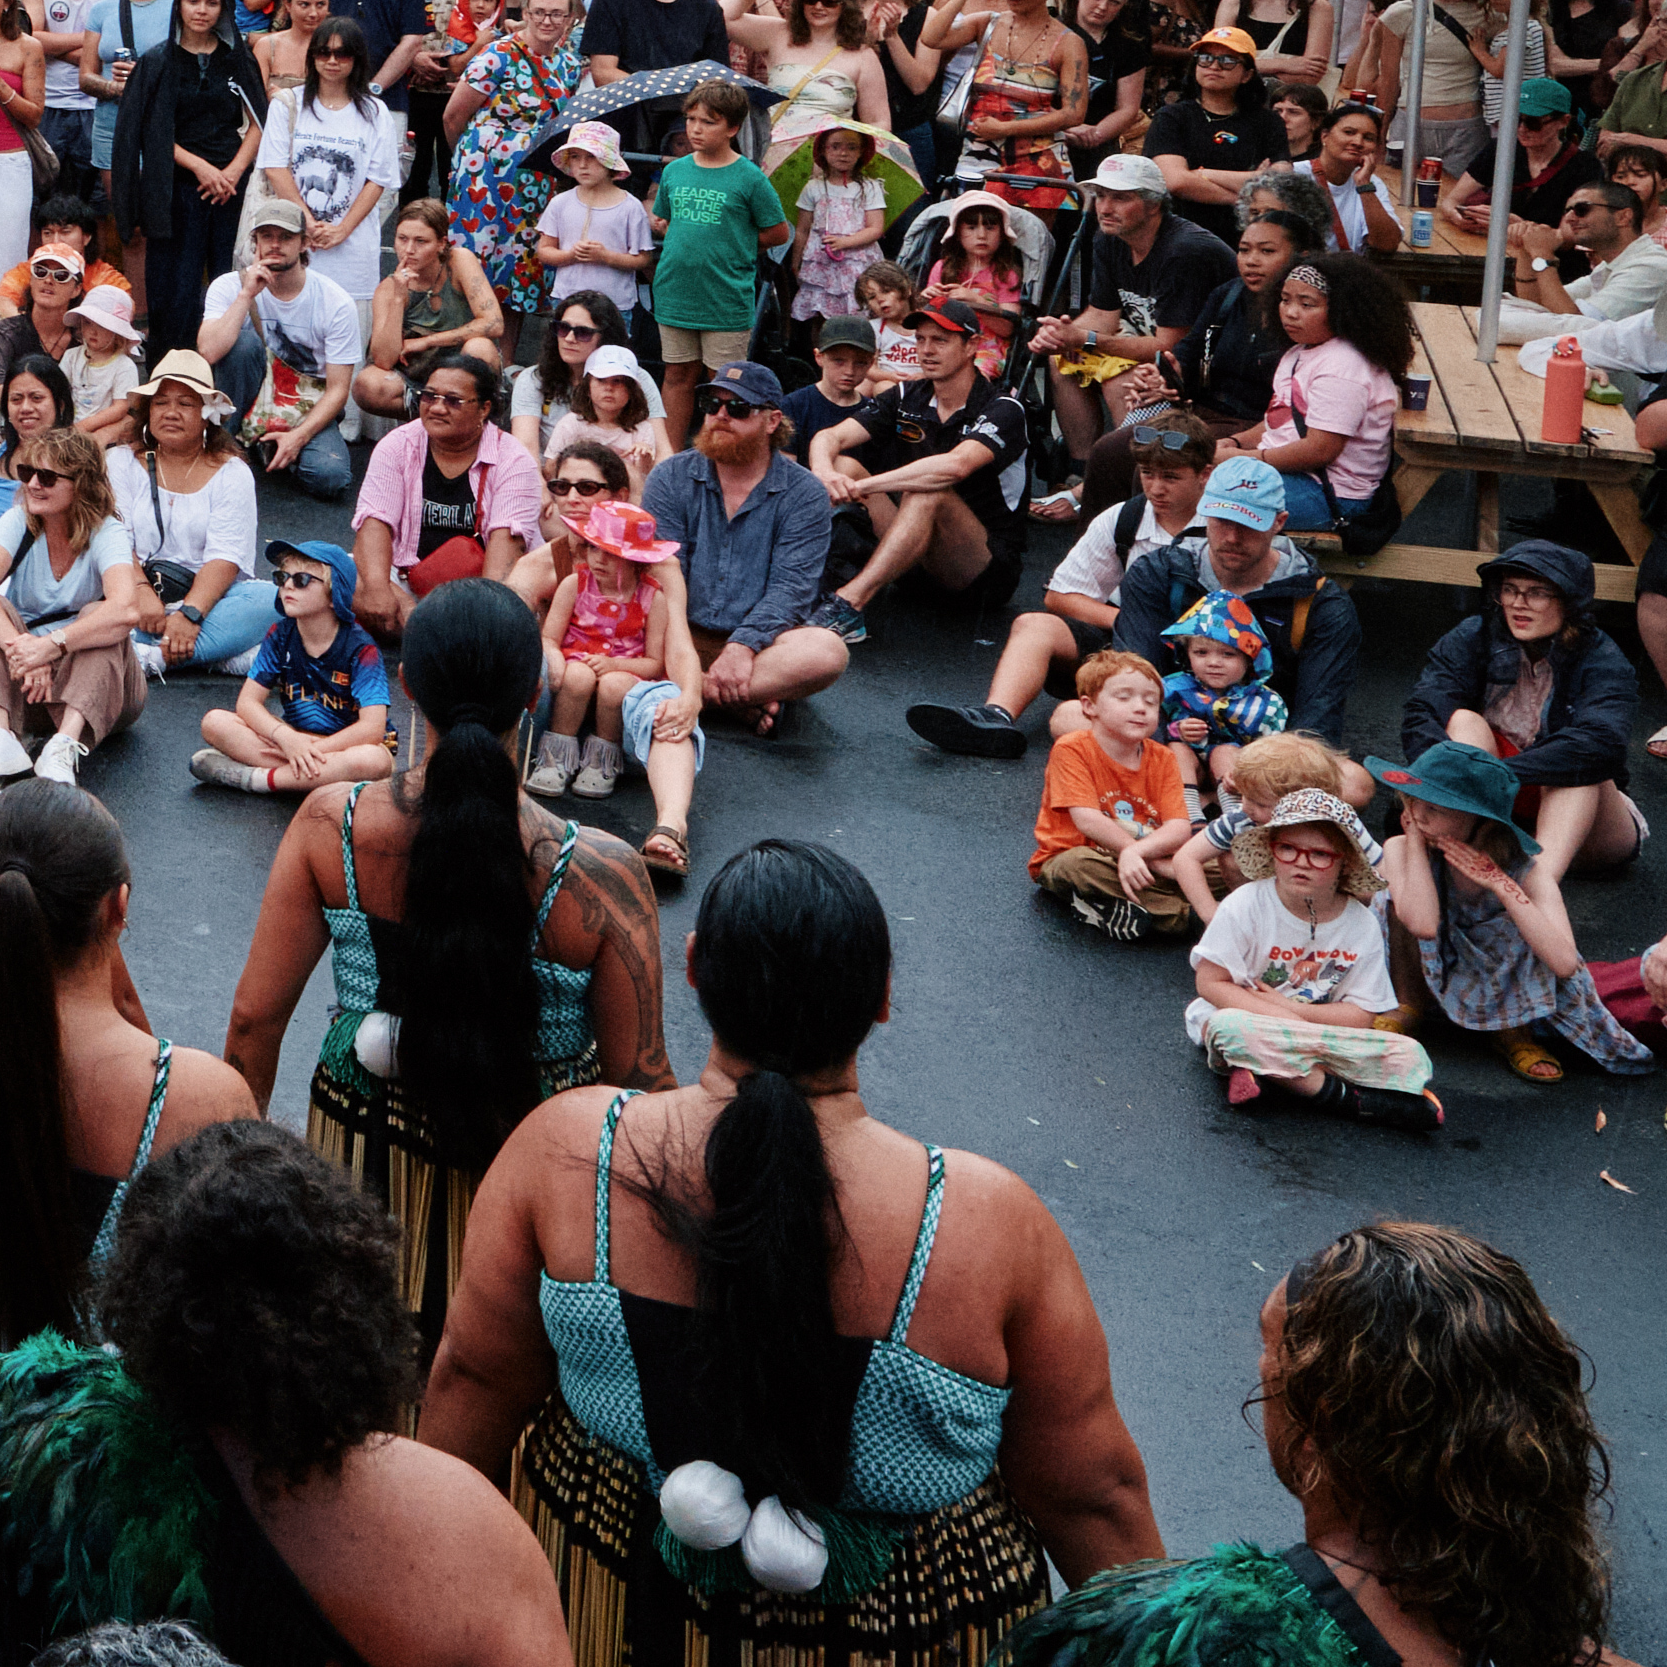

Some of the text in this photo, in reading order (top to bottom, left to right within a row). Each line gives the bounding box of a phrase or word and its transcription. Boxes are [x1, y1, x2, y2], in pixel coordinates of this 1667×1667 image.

[313, 132, 337, 144] Fortune
[338, 135, 359, 147] Beauty
[674, 186, 727, 203] LEADER
[672, 197, 724, 214] OF THE
[673, 207, 722, 225] HOUSE
[1268, 945, 1358, 962] BOW WOW
